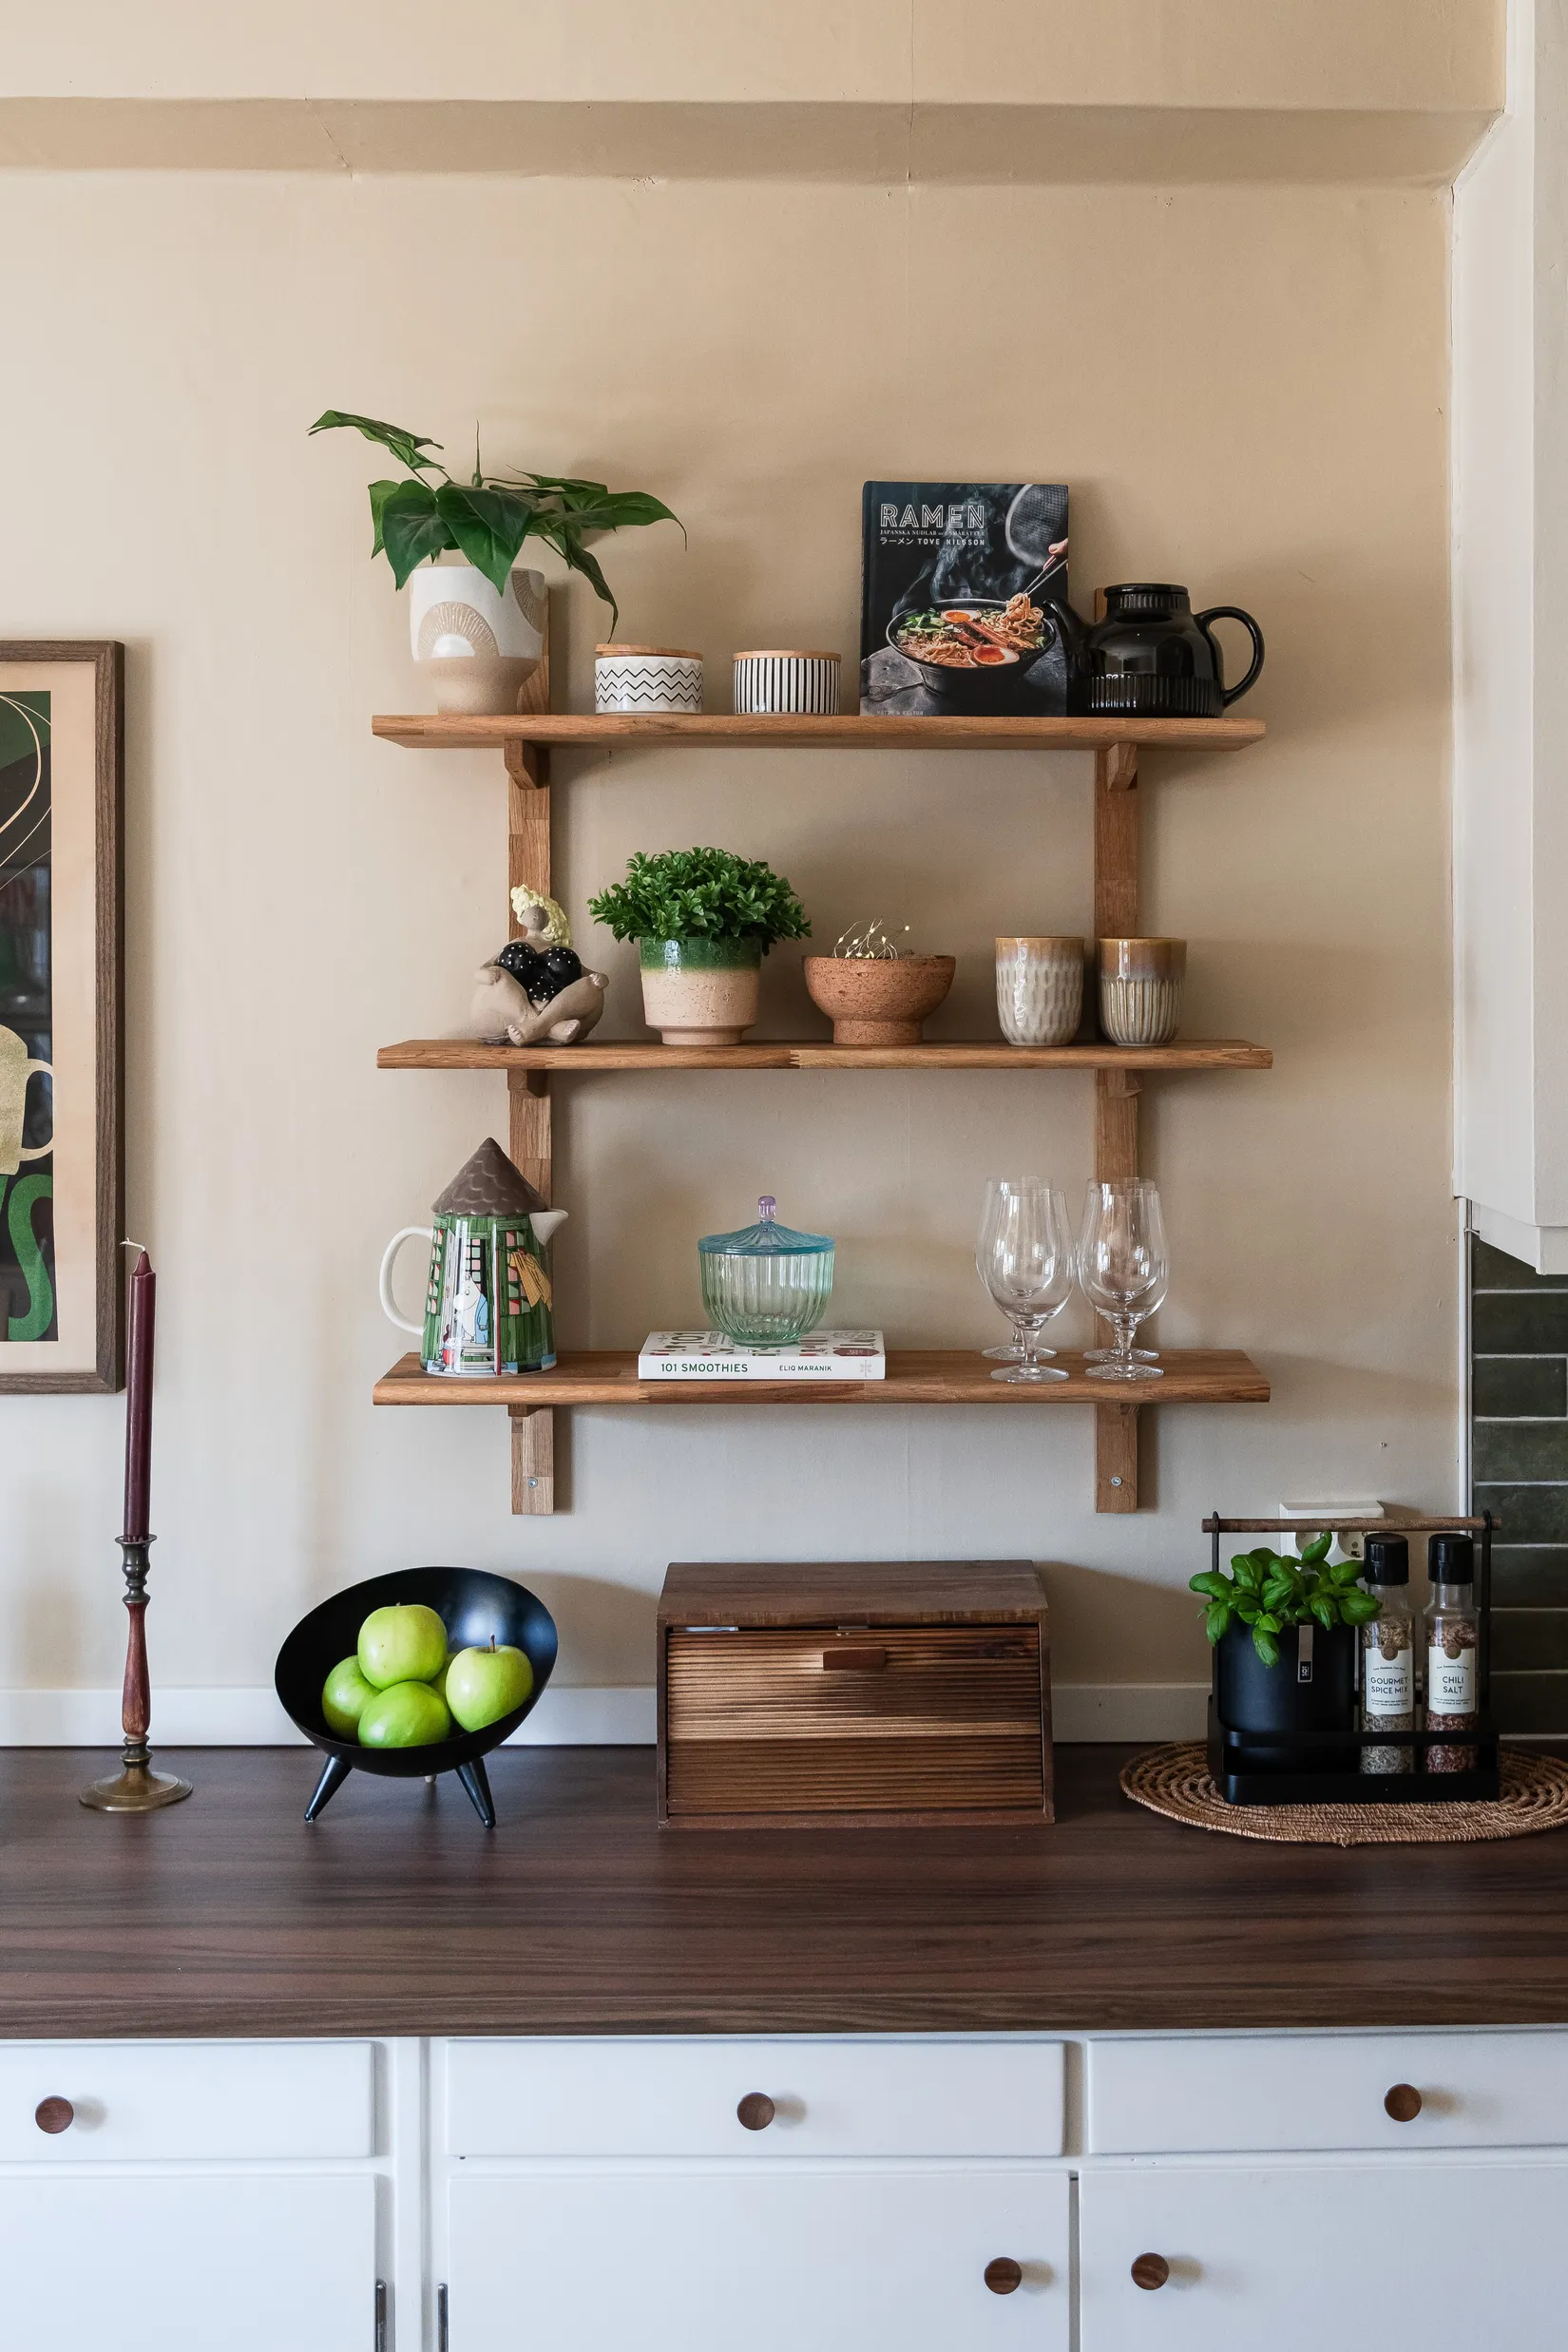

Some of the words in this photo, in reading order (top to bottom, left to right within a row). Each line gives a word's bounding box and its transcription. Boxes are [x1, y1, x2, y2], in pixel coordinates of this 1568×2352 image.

[880, 504, 985, 528] RAMEN
[660, 1363, 677, 1372] 101
[681, 1363, 749, 1372] SMOOTHIES
[1370, 1676, 1408, 1685] GOURMET
[1442, 1675, 1464, 1684] CHILI
[1370, 1686, 1393, 1694] SPICE
[1394, 1686, 1408, 1694] MIX
[1443, 1686, 1463, 1694] SALT
